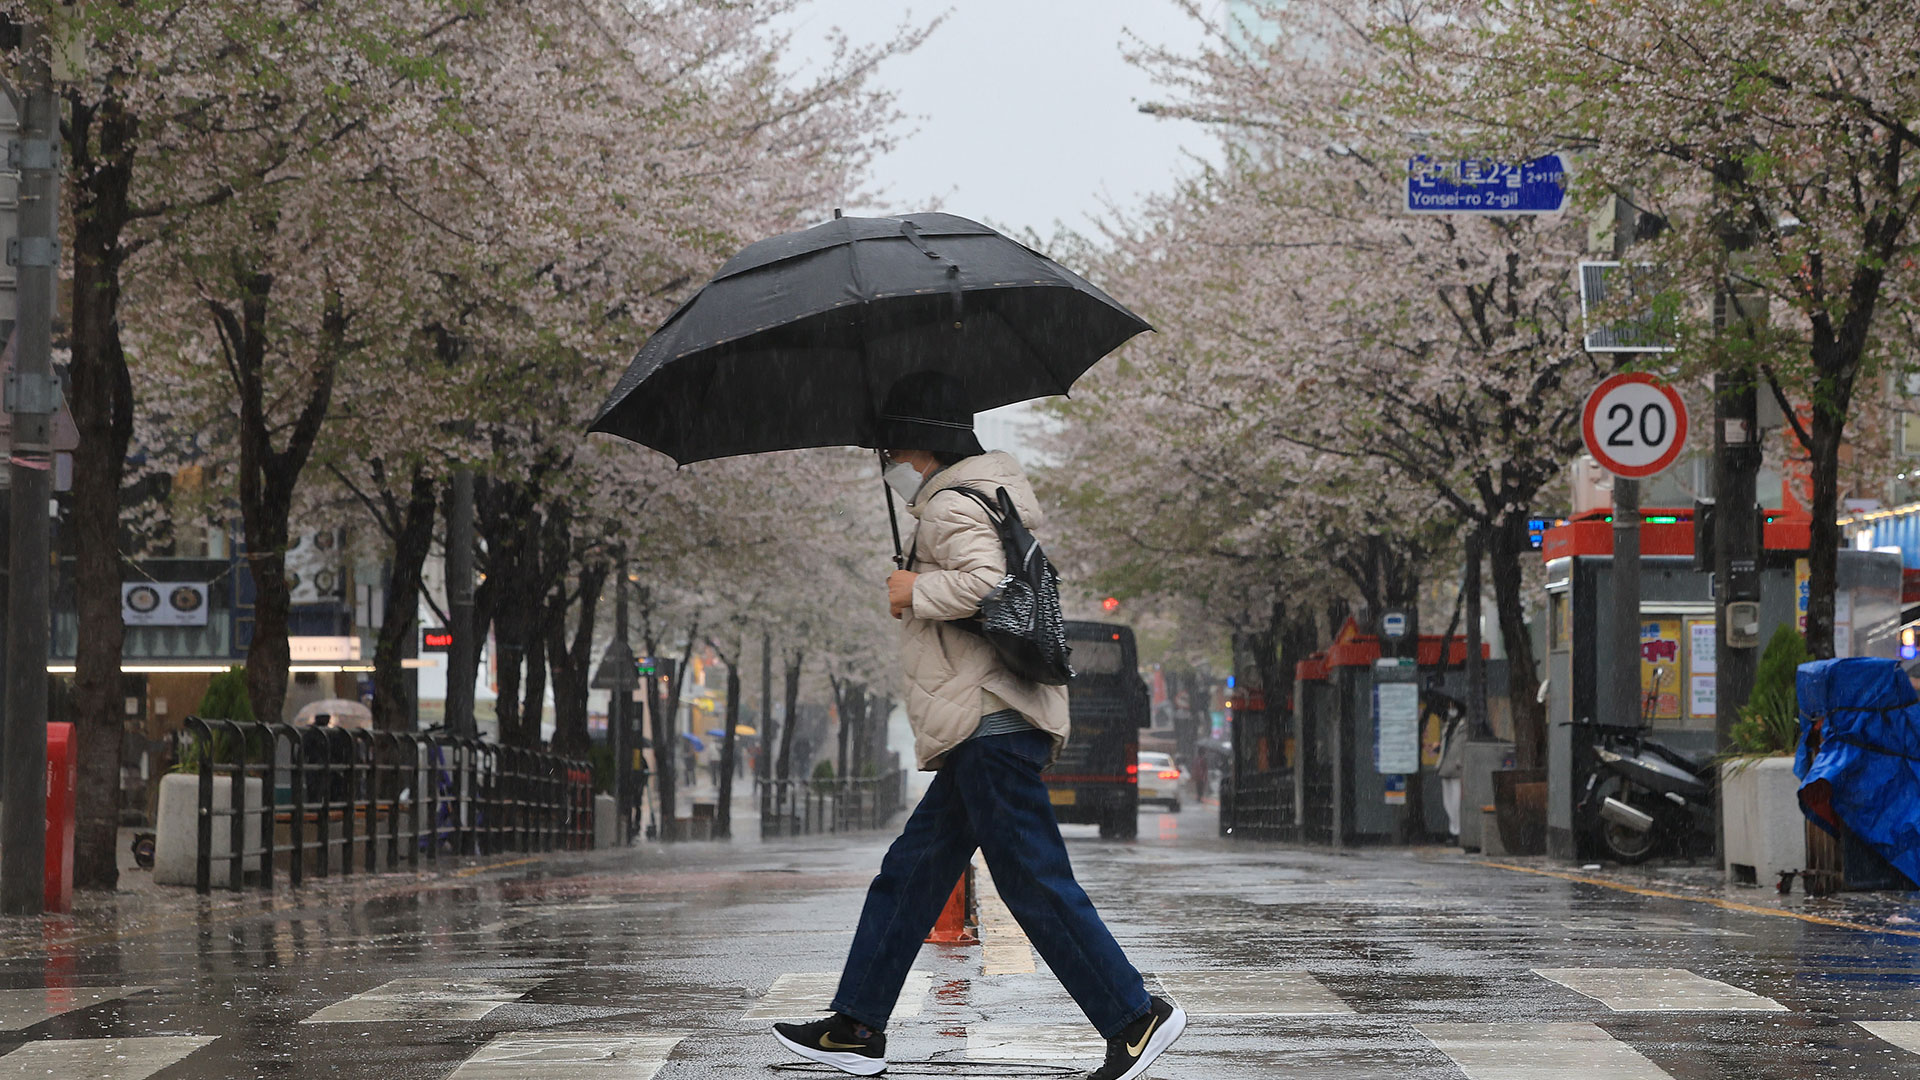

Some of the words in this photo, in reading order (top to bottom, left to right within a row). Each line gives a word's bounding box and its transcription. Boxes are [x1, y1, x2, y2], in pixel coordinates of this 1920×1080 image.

[1411, 191, 1482, 206] Yonsei-ro
[1485, 191, 1518, 208] 2-gil
[1607, 403, 1666, 447] 20
